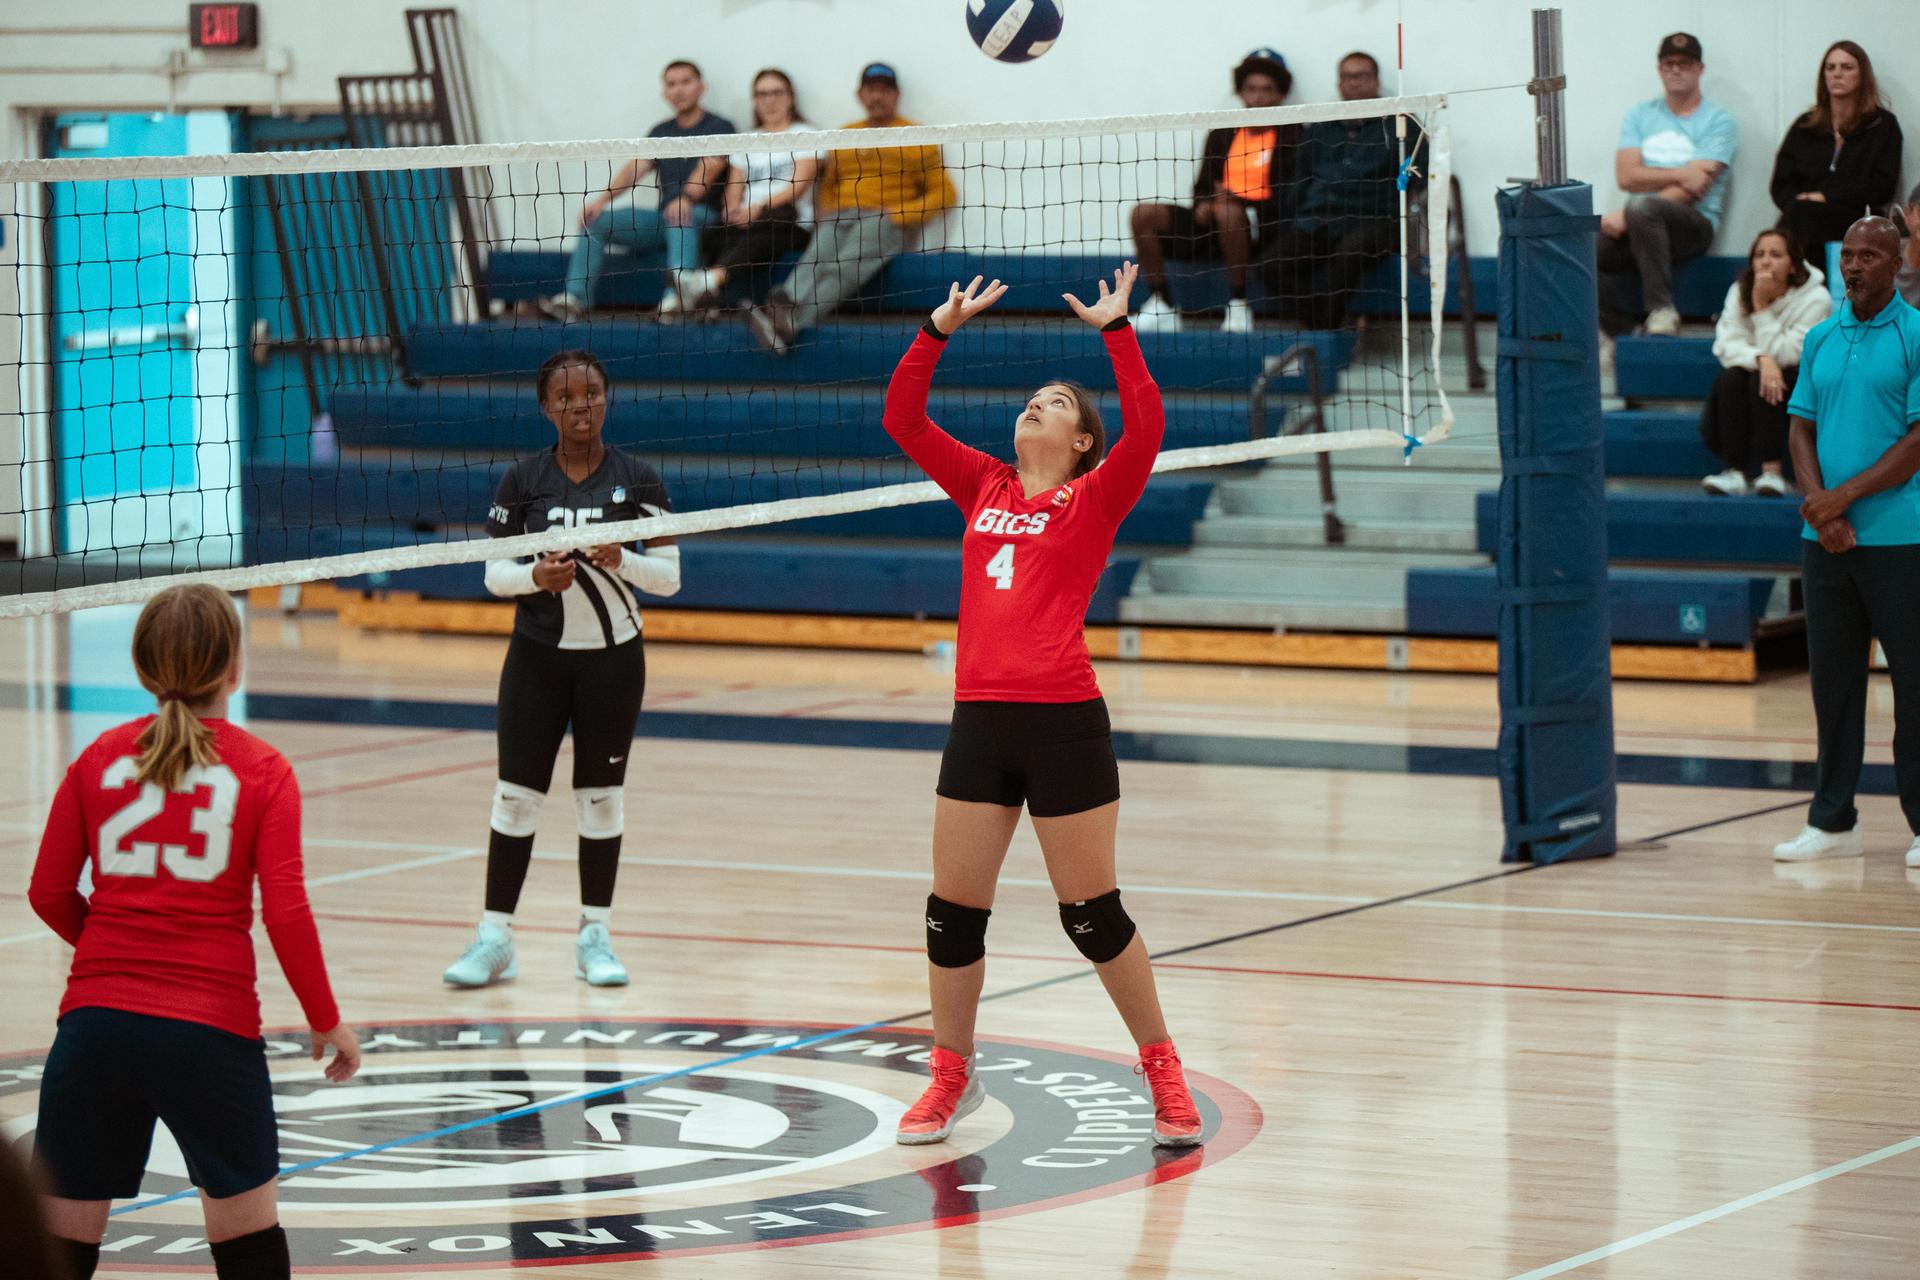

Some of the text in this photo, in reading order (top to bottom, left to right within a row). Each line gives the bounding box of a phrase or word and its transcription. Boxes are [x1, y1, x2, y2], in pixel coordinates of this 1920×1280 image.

[202, 8, 239, 44] EXIT
[974, 507, 1051, 535] GICS
[985, 543, 1016, 590] 4
[98, 756, 241, 883] 23
[1013, 1072, 1155, 1168] CLIPPERS
[331, 1202, 889, 1256] LENNOX
